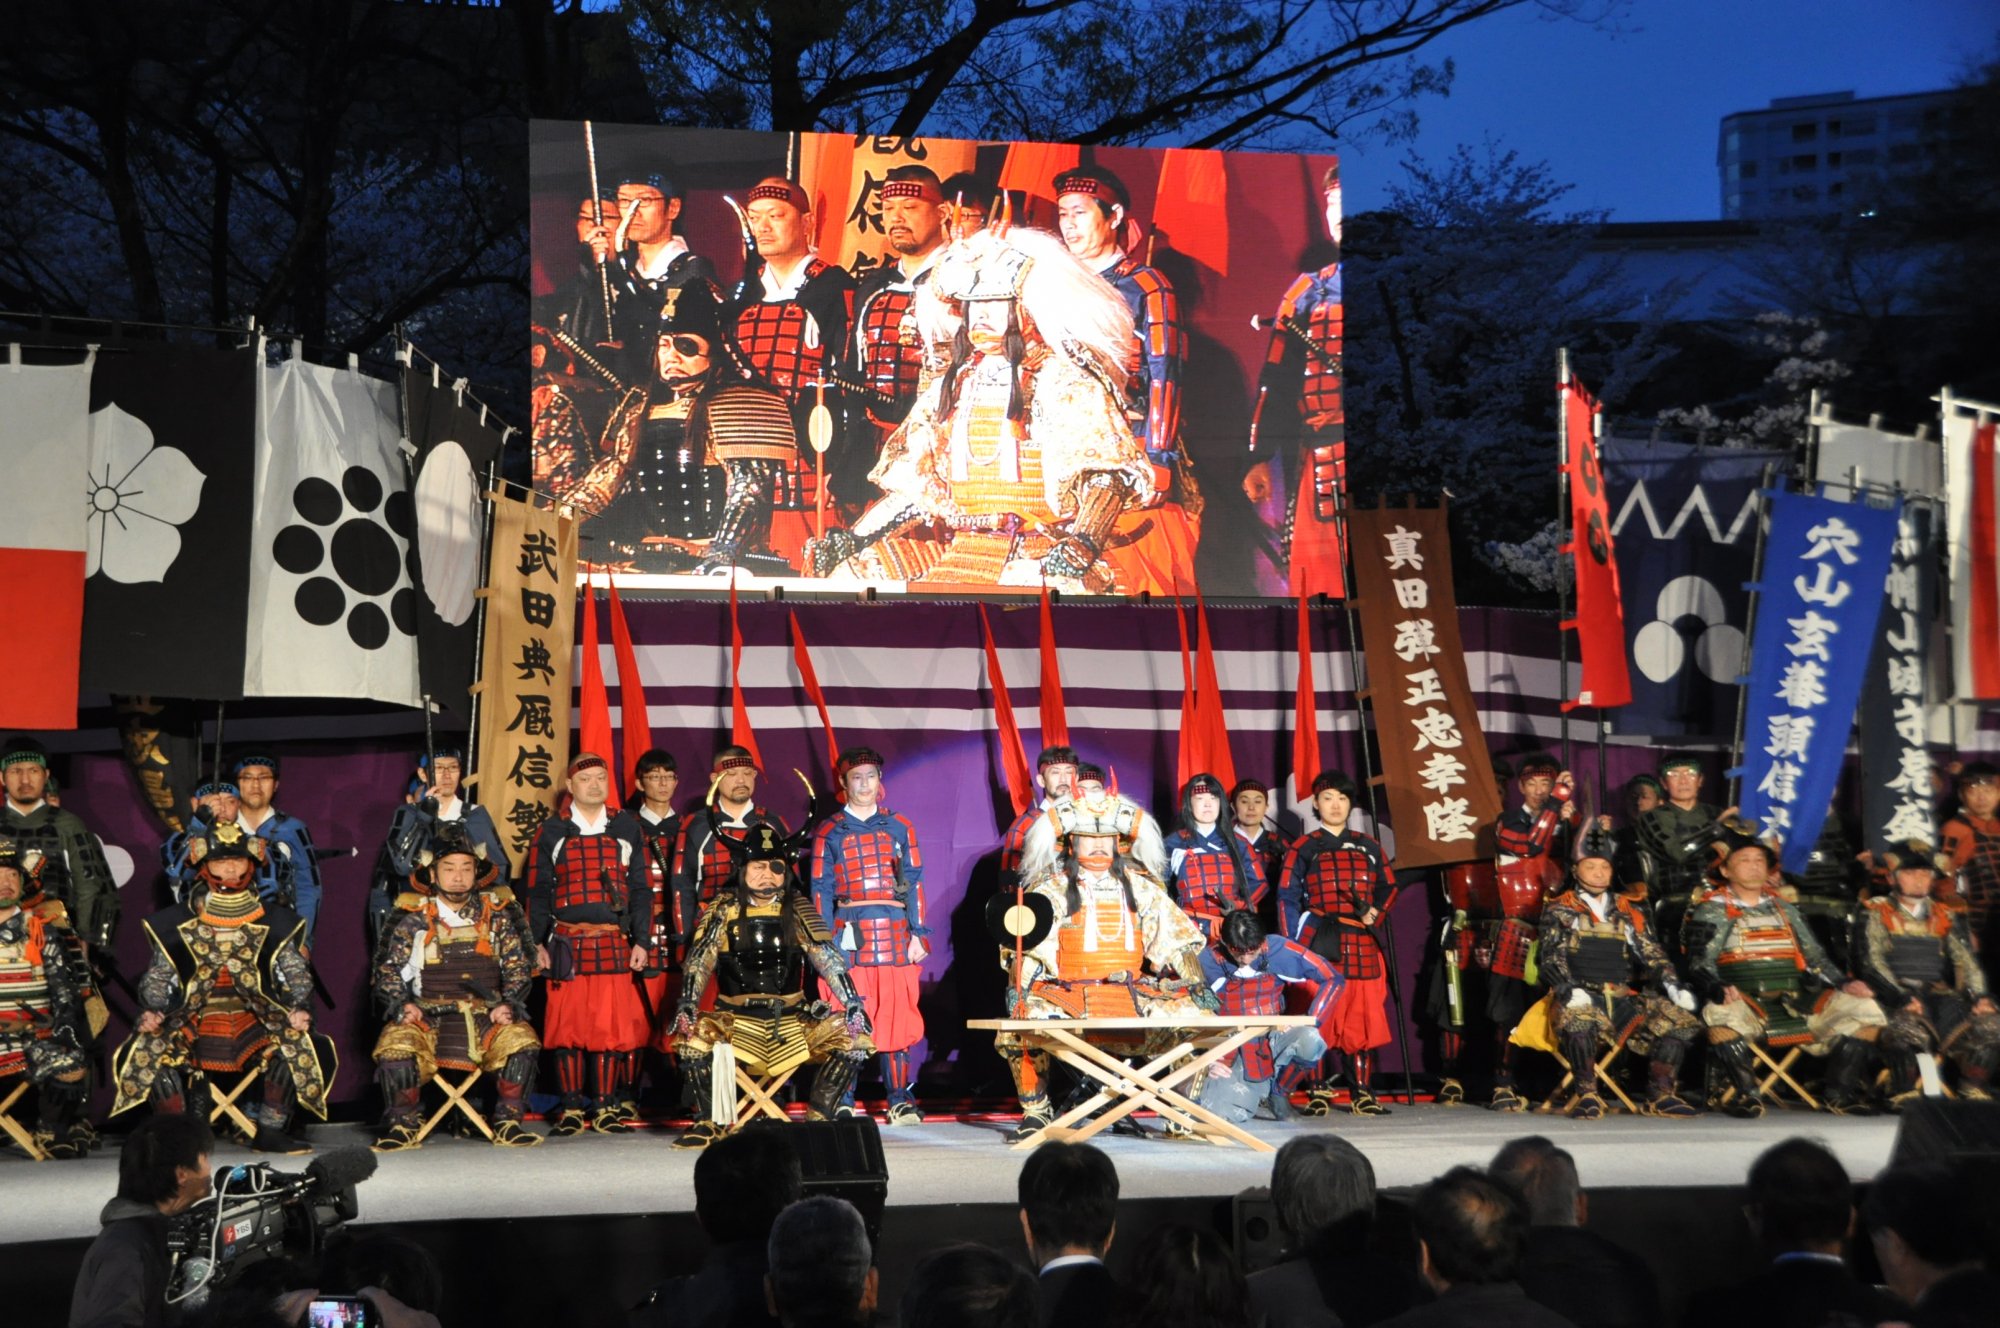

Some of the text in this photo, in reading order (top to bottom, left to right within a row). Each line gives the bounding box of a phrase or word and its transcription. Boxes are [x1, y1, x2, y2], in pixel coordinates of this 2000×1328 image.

[1383, 525, 1478, 843] 真田弾正忠幸隆
[263, 1225, 271, 1235] 2
